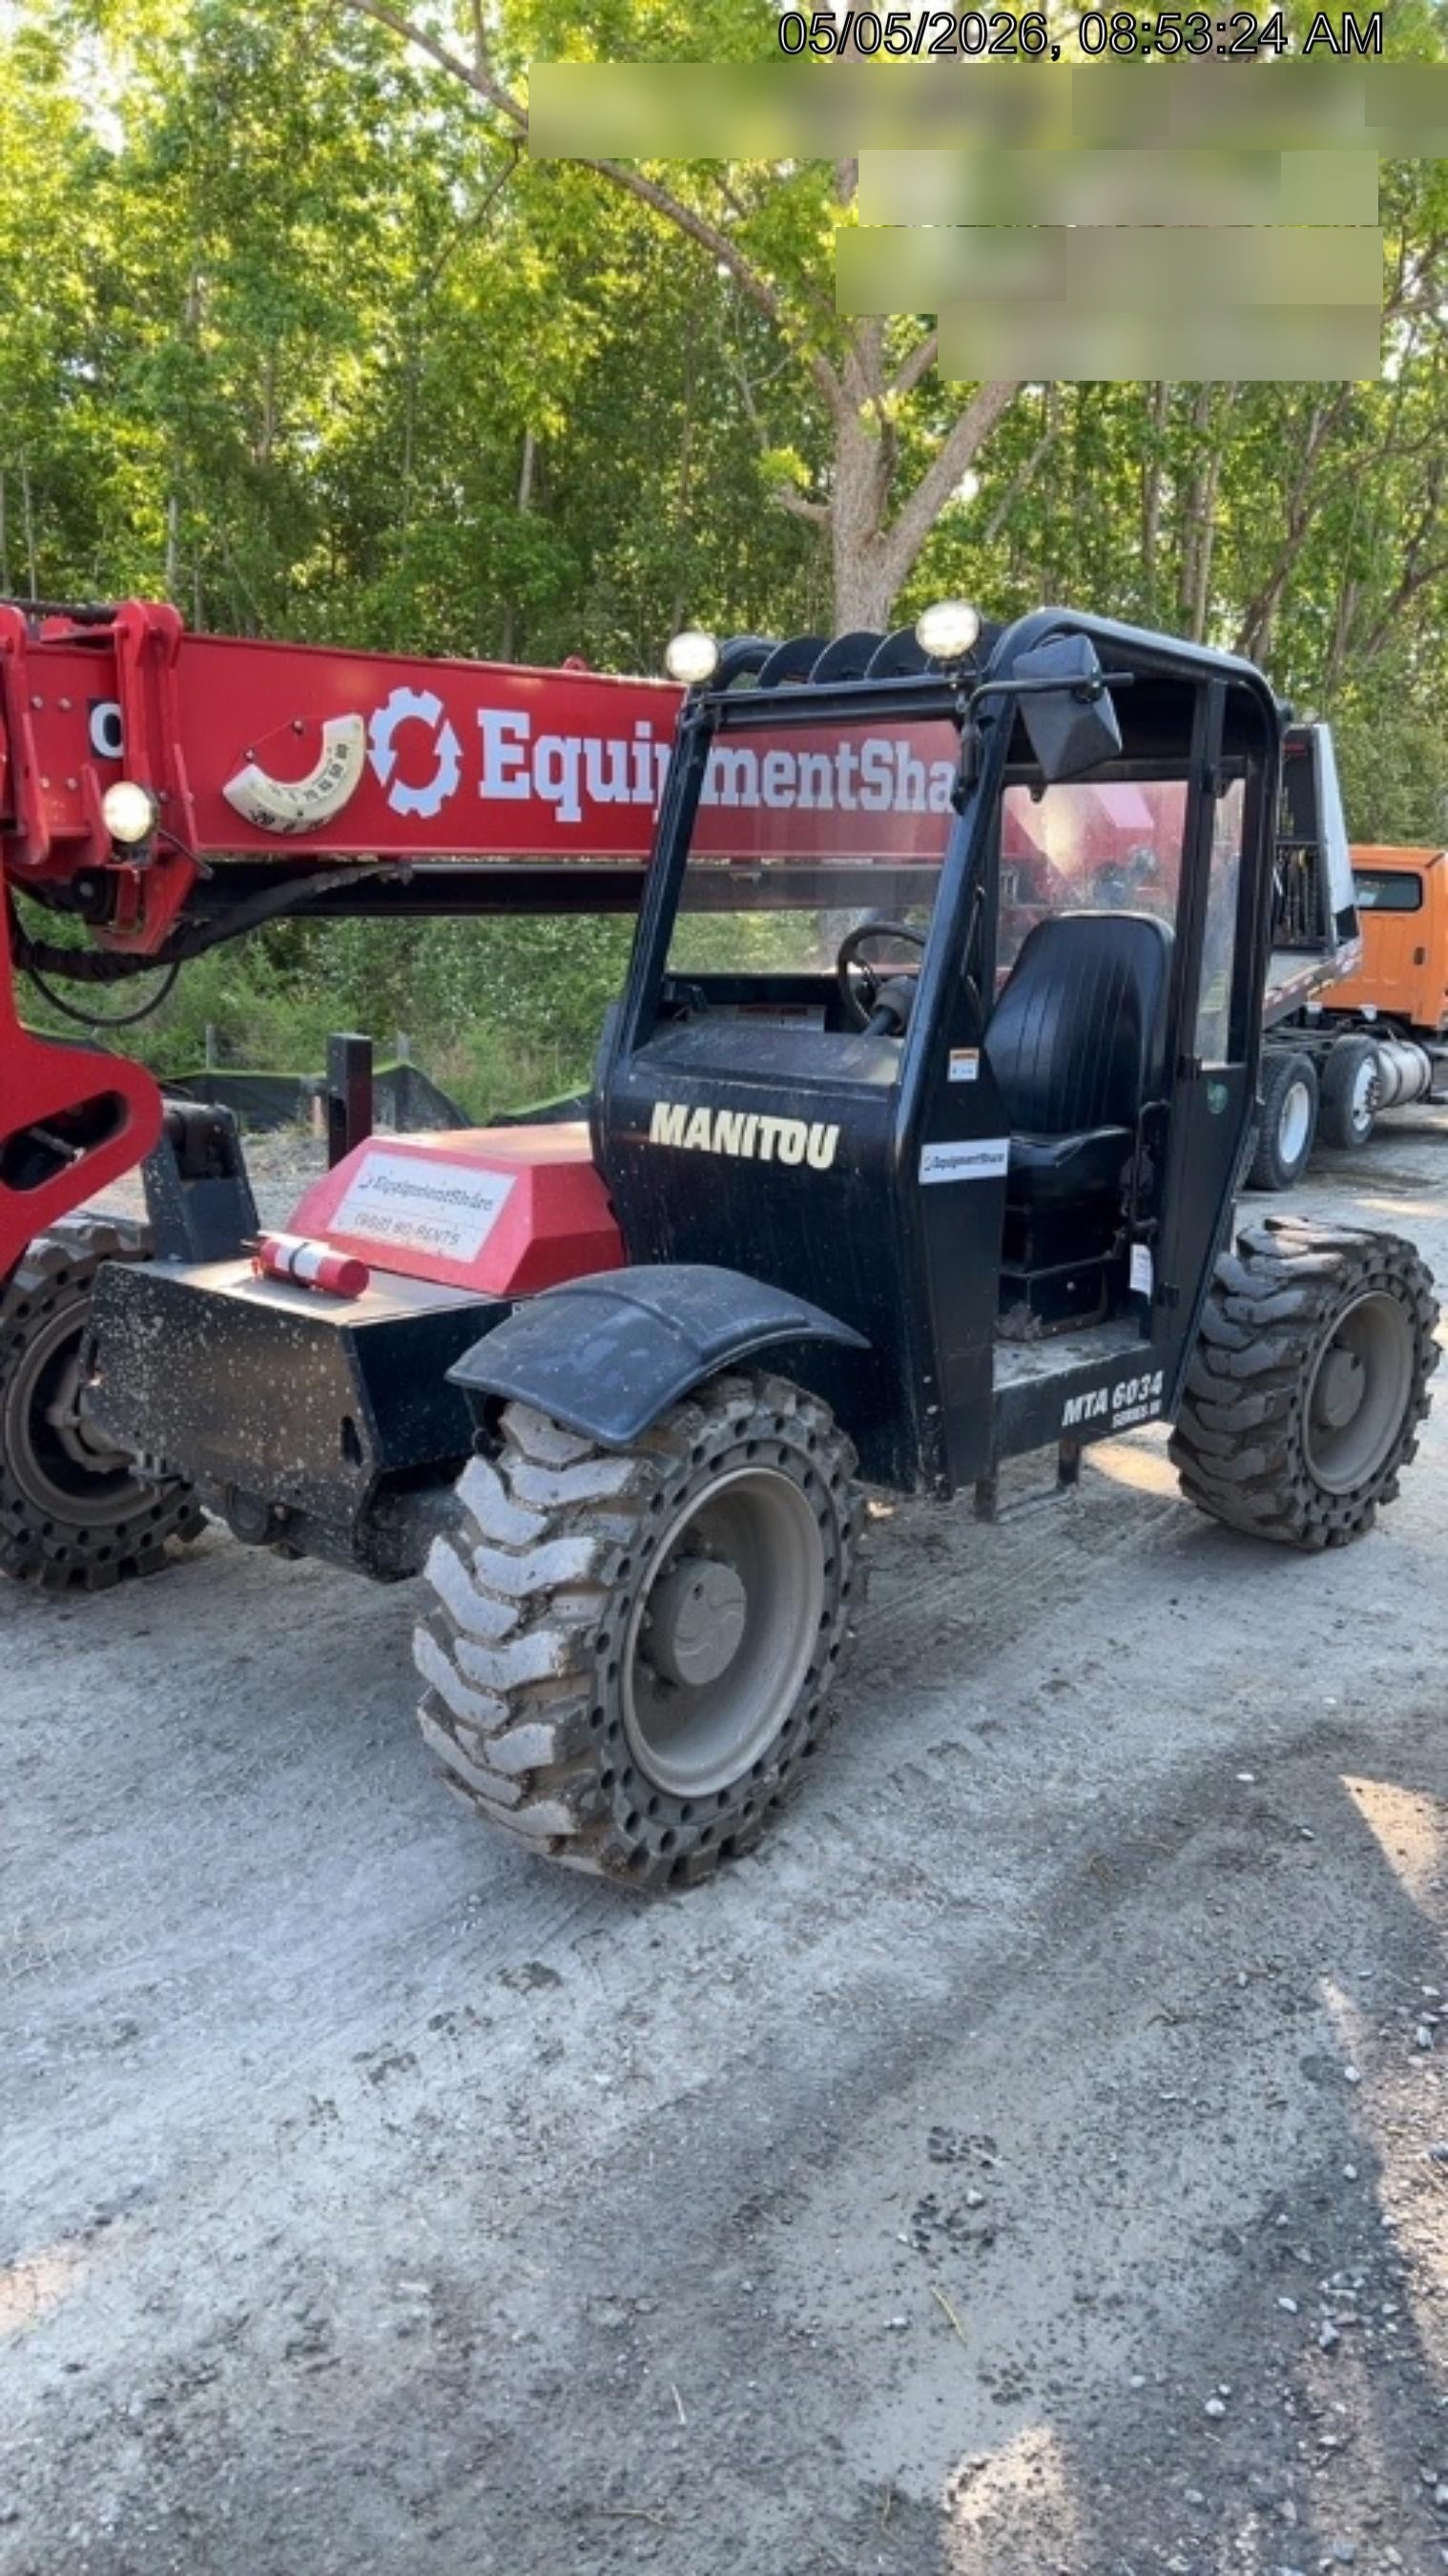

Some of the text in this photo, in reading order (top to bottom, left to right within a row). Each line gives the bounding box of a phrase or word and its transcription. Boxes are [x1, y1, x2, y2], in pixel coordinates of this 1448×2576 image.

[649, 1101, 839, 1170] MANITOU
[1061, 1370, 1164, 1427] MTA 6034
